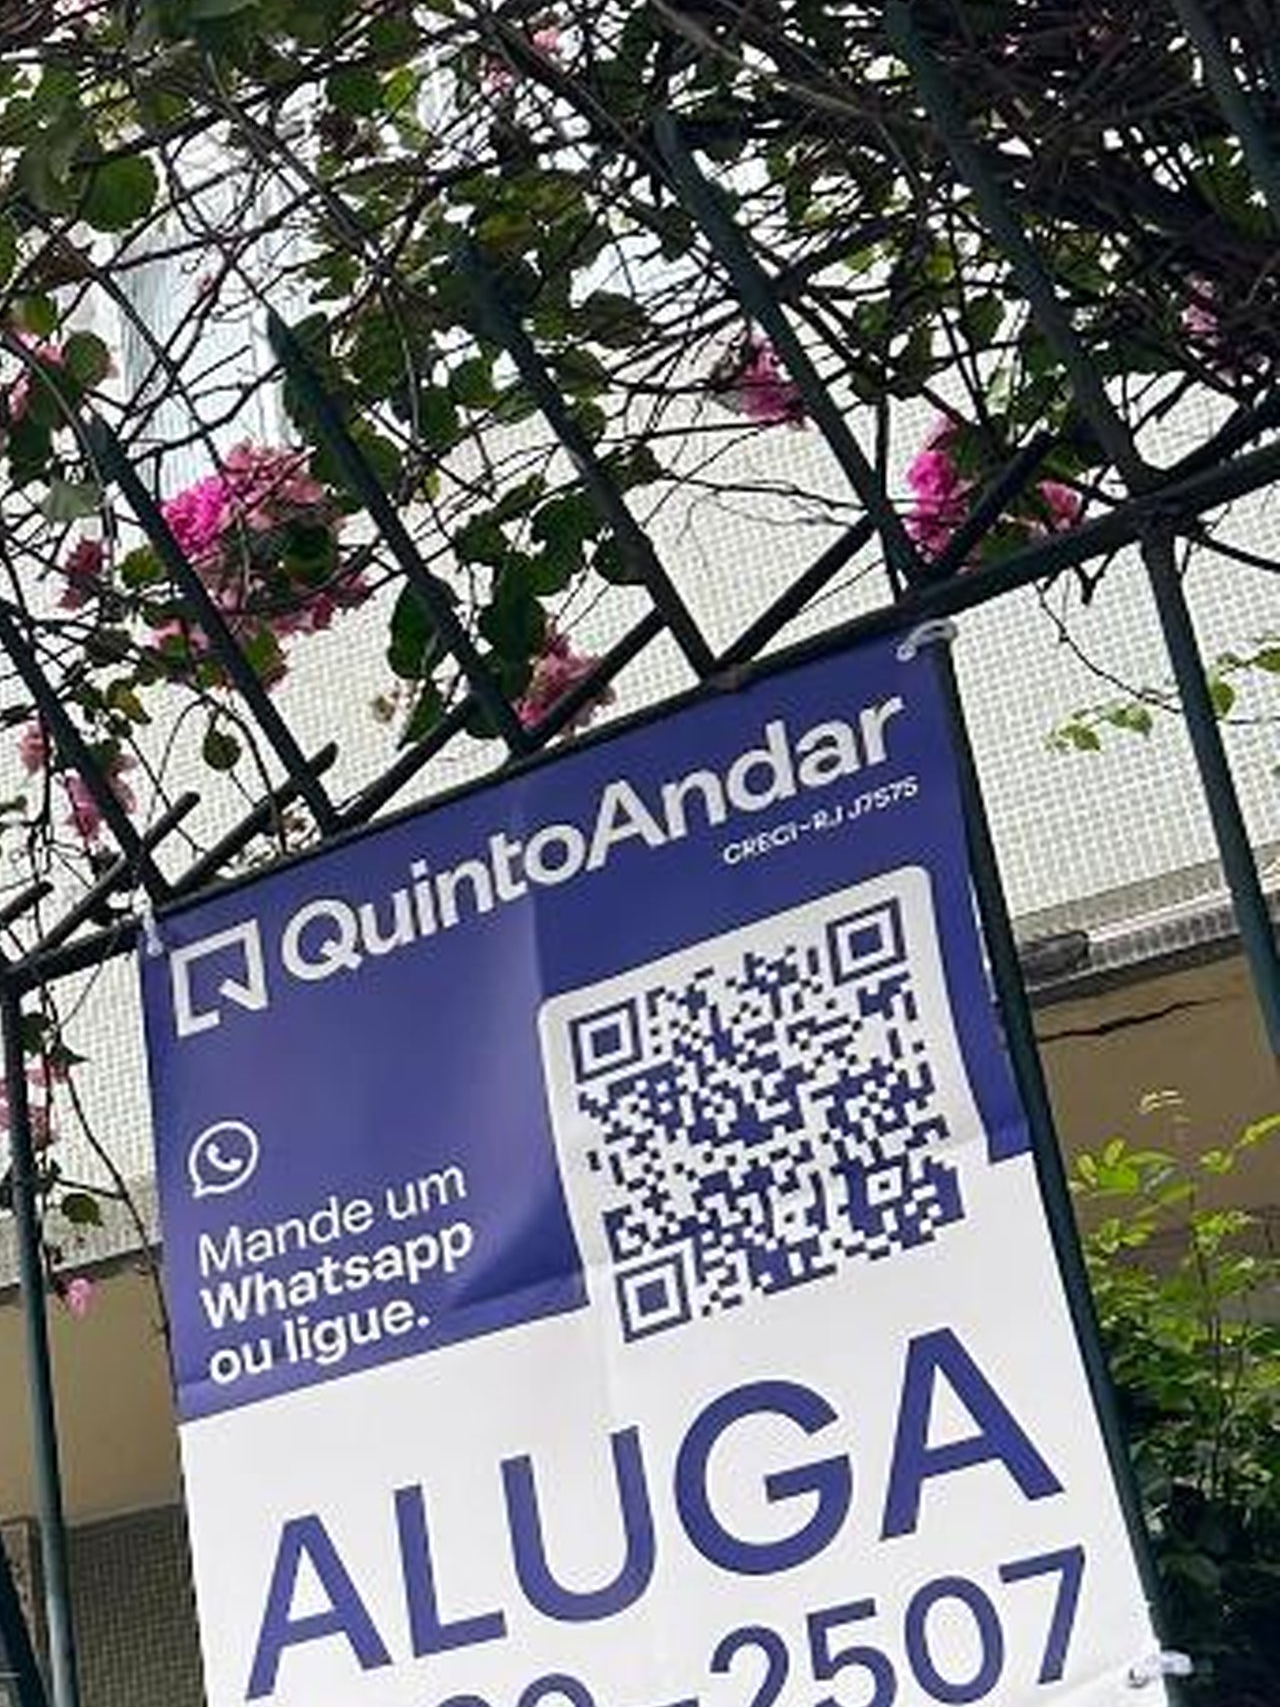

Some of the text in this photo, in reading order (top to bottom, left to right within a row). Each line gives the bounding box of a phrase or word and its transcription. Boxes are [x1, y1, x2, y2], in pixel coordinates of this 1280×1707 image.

[282, 697, 905, 982] QuintoAndar
[723, 806, 842, 864] CRECI-RJ
[199, 1166, 467, 1276] Mande um
[200, 1222, 473, 1328] Whatsapp
[210, 1300, 430, 1382] ou ligue.
[246, 1328, 1064, 1699] ALUGA
